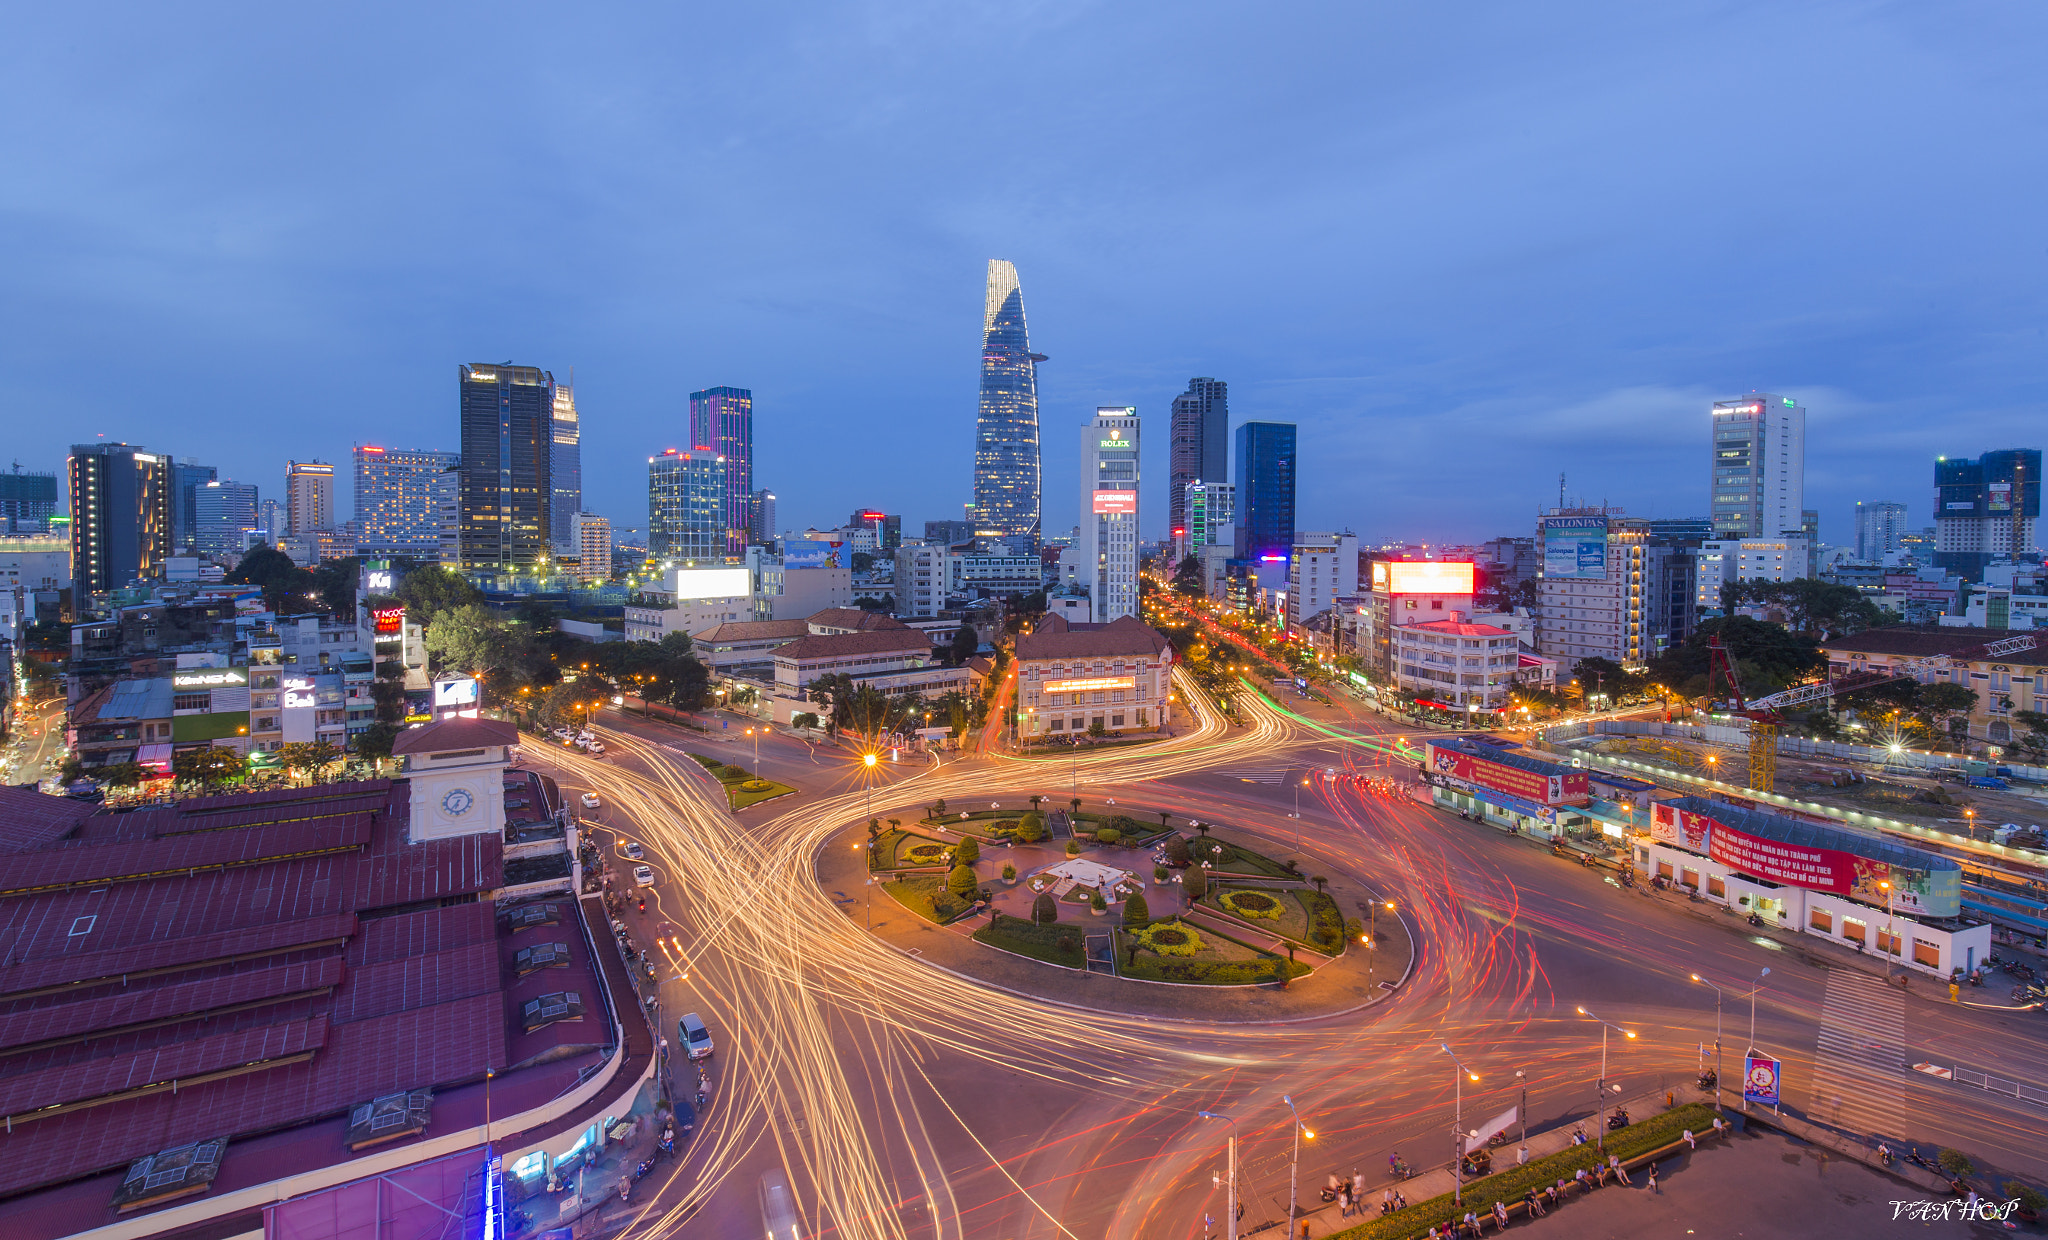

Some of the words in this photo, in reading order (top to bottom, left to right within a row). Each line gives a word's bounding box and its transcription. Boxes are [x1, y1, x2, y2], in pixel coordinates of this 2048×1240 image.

[1548, 519, 1604, 528] SALONPAS
[1816, 866, 1832, 875] THEO
[1764, 866, 1782, 877] PHONG
[1783, 870, 1798, 880] CÁCH
[1808, 875, 1818, 884] CHÍ
[1818, 877, 1834, 886] MINH
